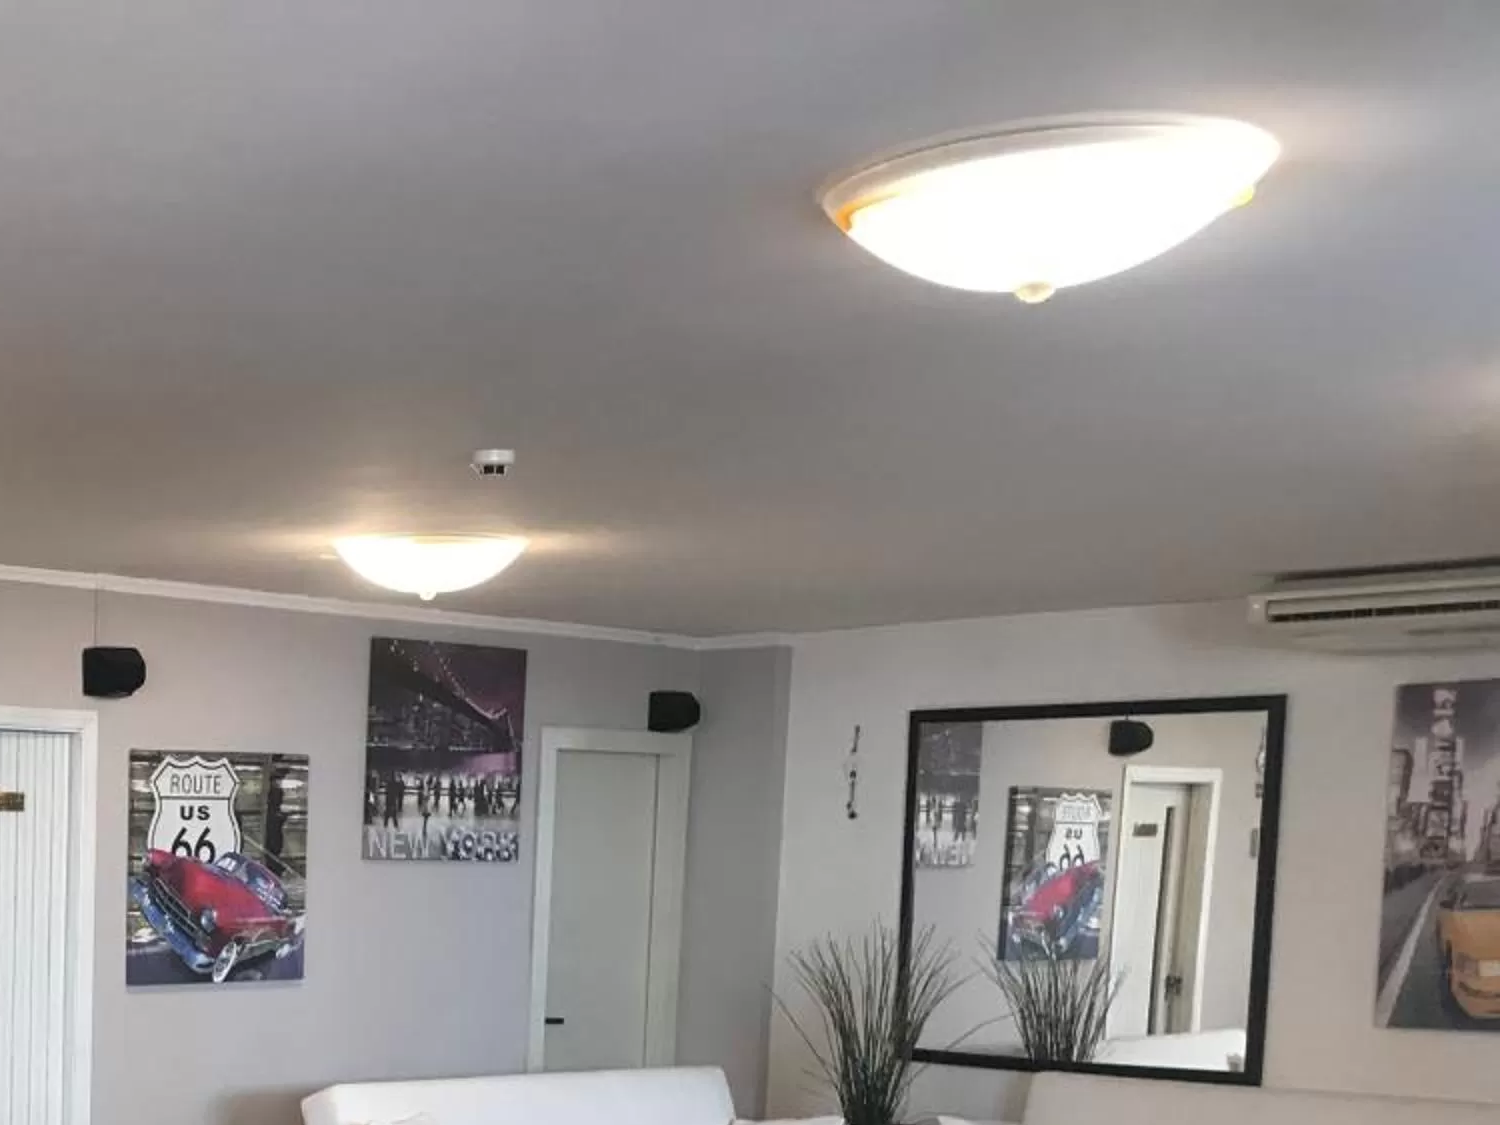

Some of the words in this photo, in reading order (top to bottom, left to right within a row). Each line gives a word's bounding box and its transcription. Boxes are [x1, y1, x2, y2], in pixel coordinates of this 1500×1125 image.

[169, 773, 222, 795] ROUTE
[179, 805, 211, 821] US
[171, 827, 216, 864] 66
[367, 827, 430, 859] NEW
